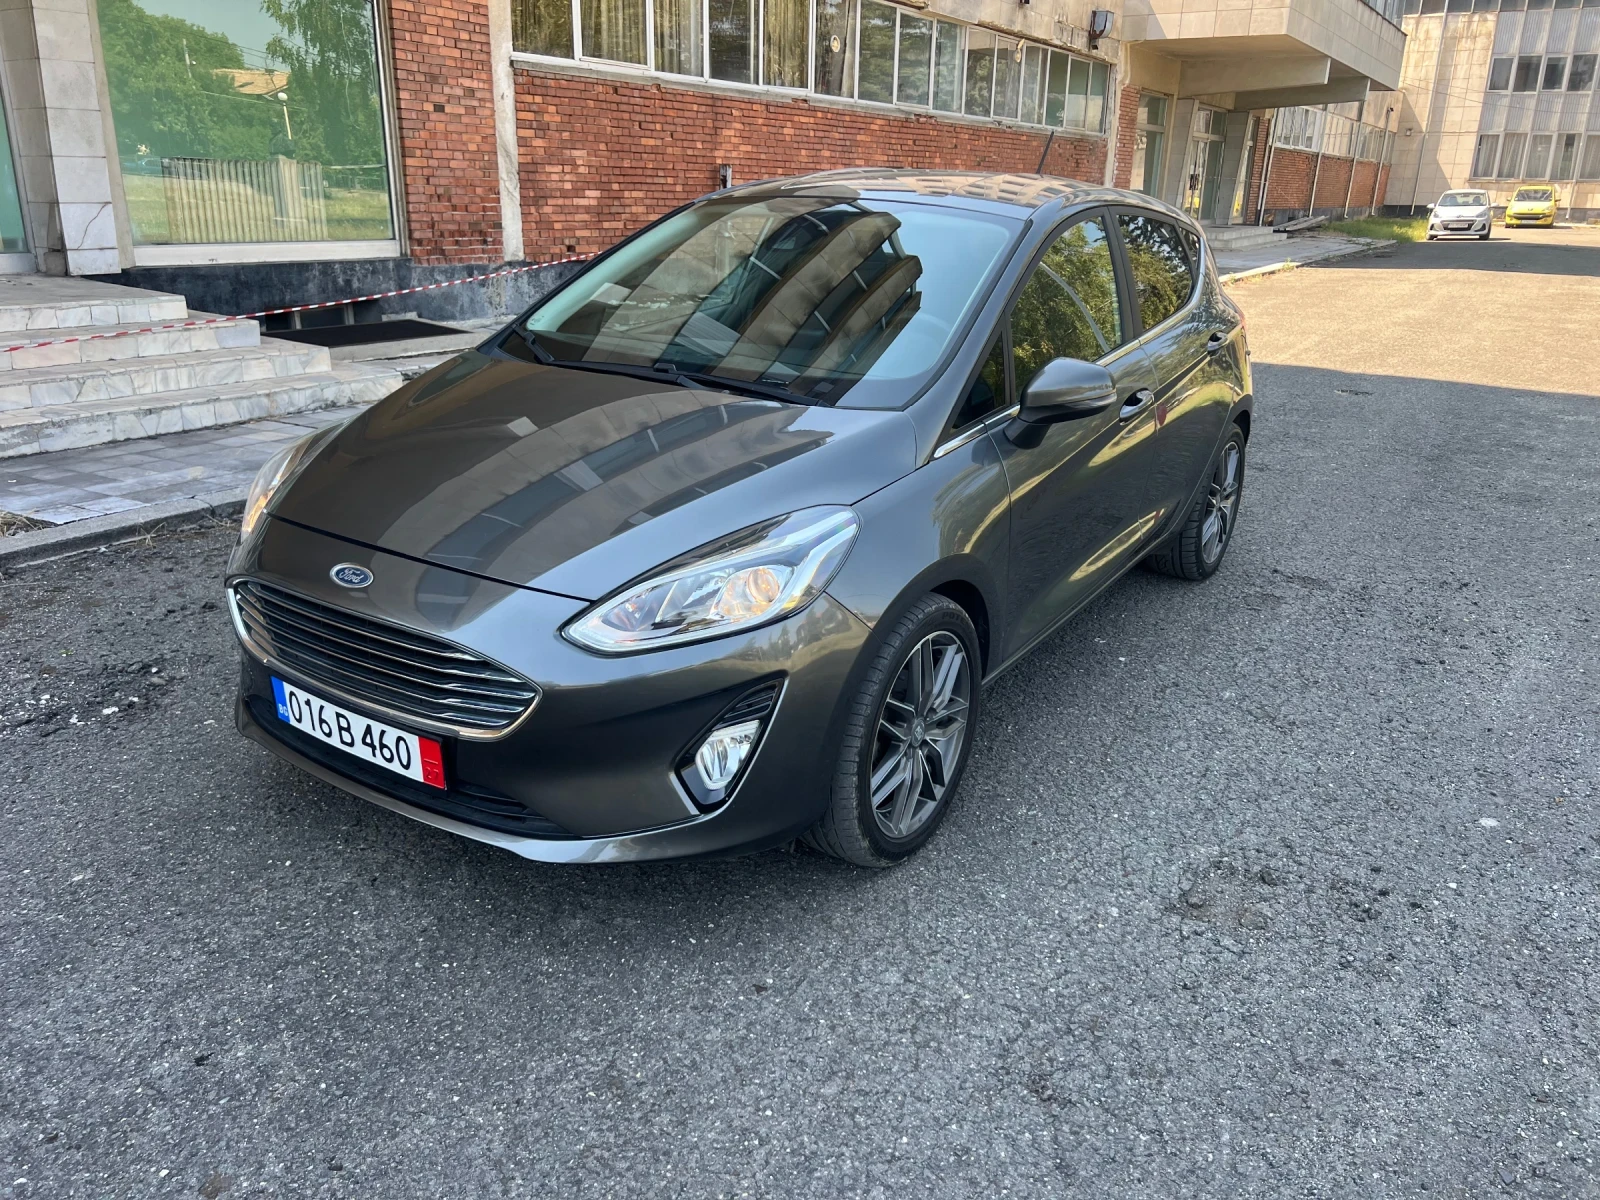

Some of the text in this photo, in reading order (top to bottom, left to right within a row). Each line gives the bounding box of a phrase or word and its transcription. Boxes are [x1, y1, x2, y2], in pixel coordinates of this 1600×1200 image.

[338, 568, 365, 583] Ford
[278, 703, 289, 717] BG
[361, 723, 411, 771] 460
